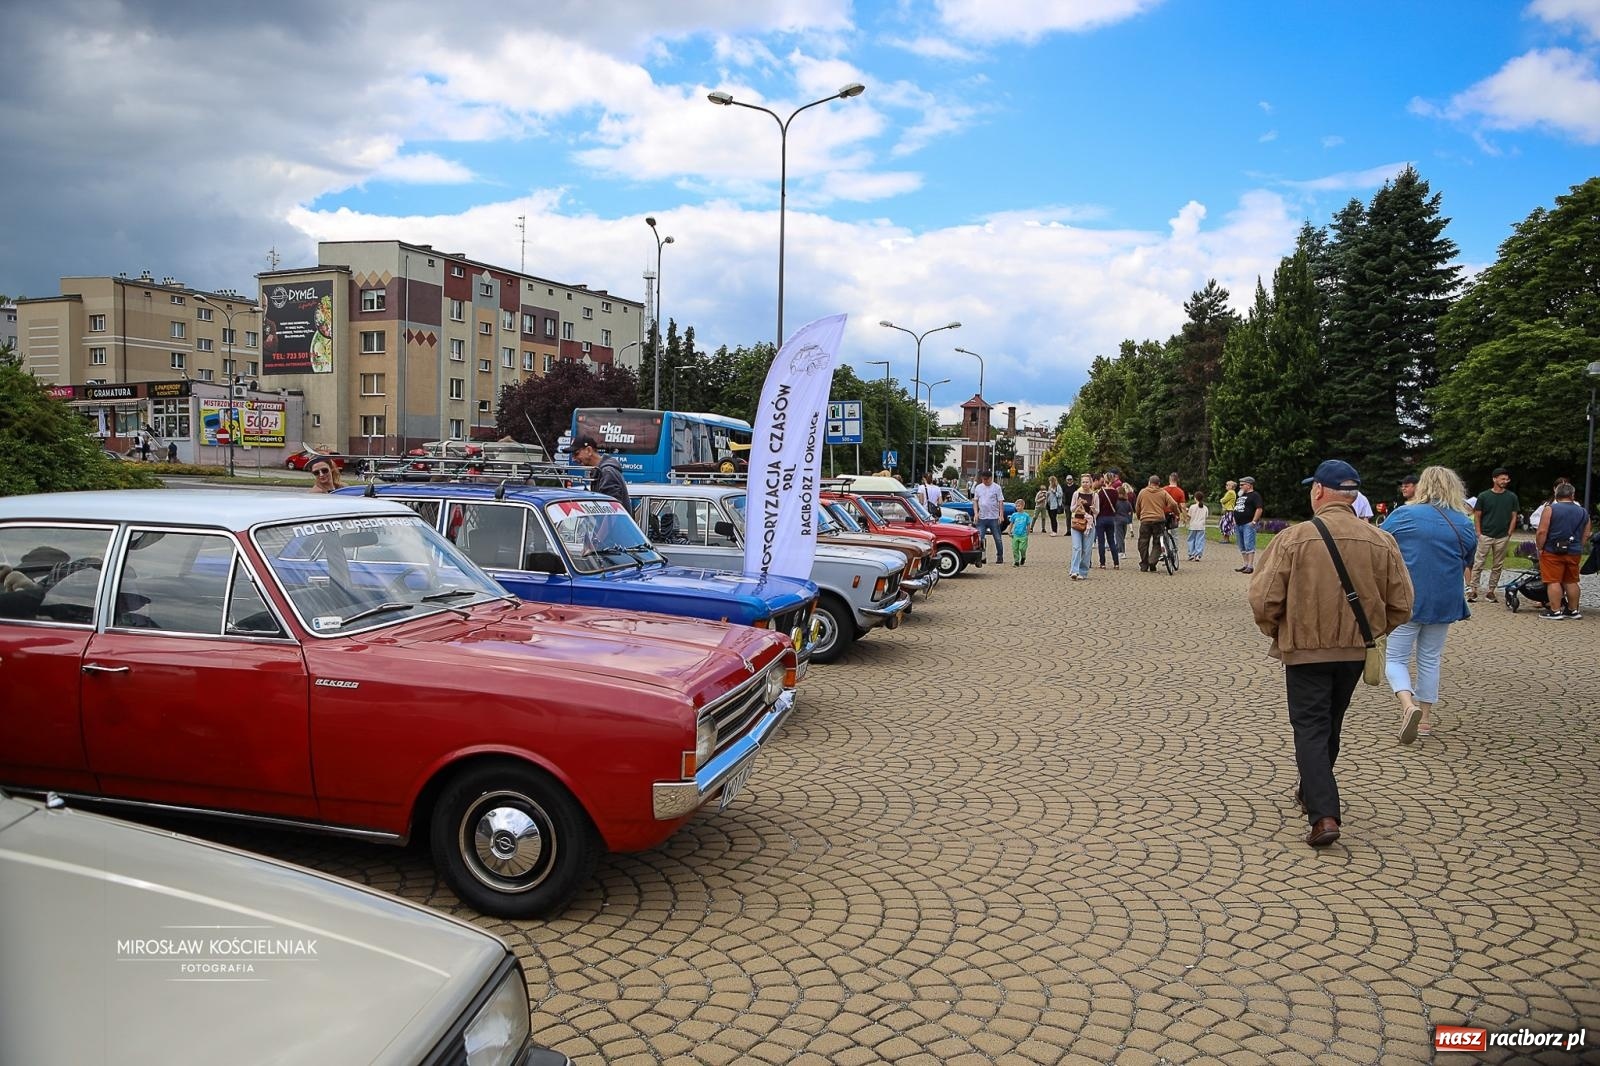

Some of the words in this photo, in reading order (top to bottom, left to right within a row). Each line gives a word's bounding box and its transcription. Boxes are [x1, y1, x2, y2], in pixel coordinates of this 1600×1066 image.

[288, 287, 318, 300] DYMEL
[93, 387, 132, 397] GRAMATURA
[769, 384, 791, 453] CZASÓW
[782, 464, 797, 490] PRL
[799, 476, 814, 536] RACIBÓRZ
[315, 679, 359, 689] REKORD
